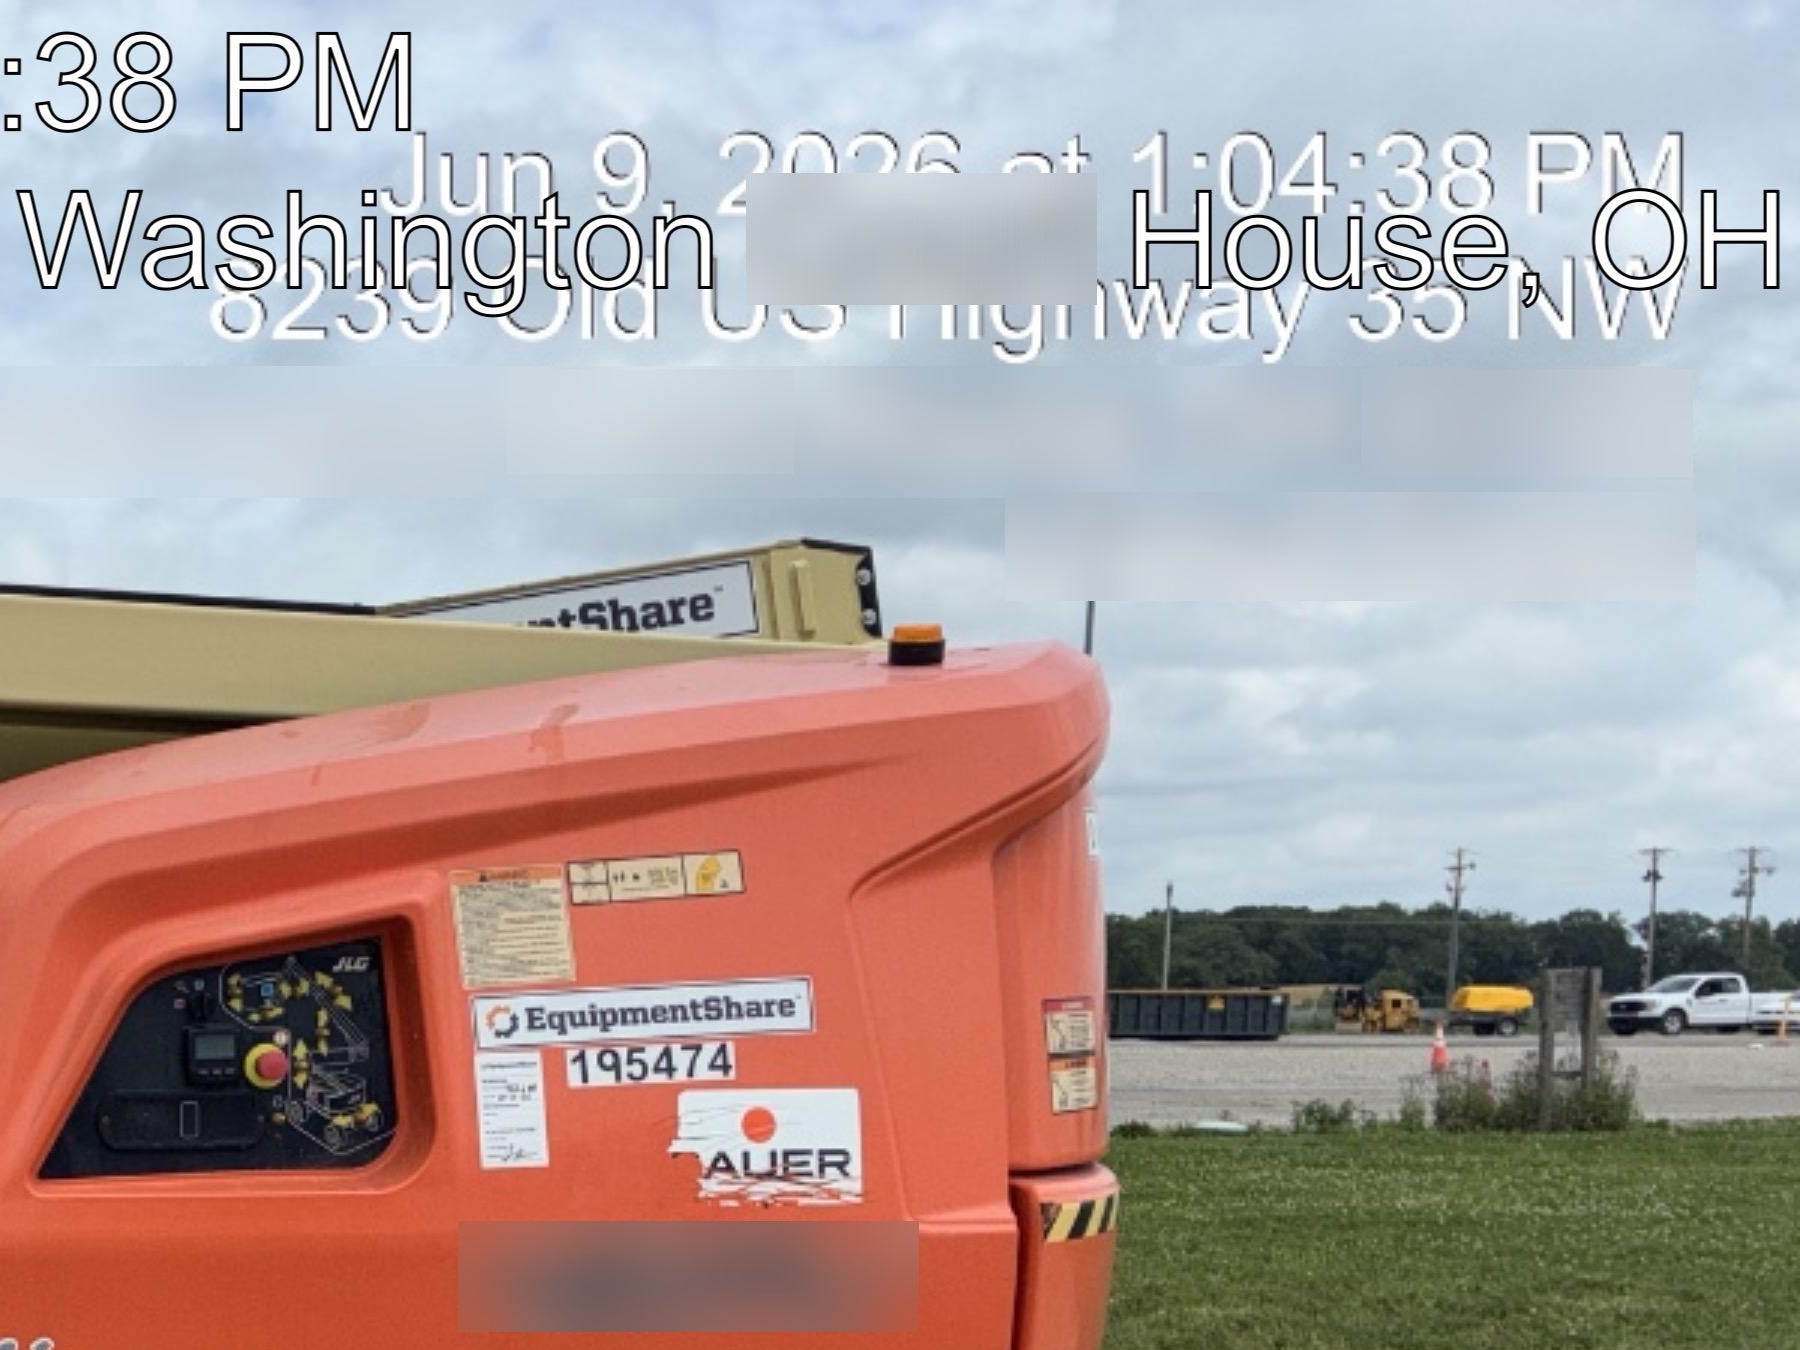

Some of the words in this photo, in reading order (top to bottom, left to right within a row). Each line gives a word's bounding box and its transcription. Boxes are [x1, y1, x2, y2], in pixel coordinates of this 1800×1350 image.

[526, 996, 796, 1037] EquipmentShare
[571, 1043, 733, 1083] 195474
[703, 1148, 853, 1180] AUER
